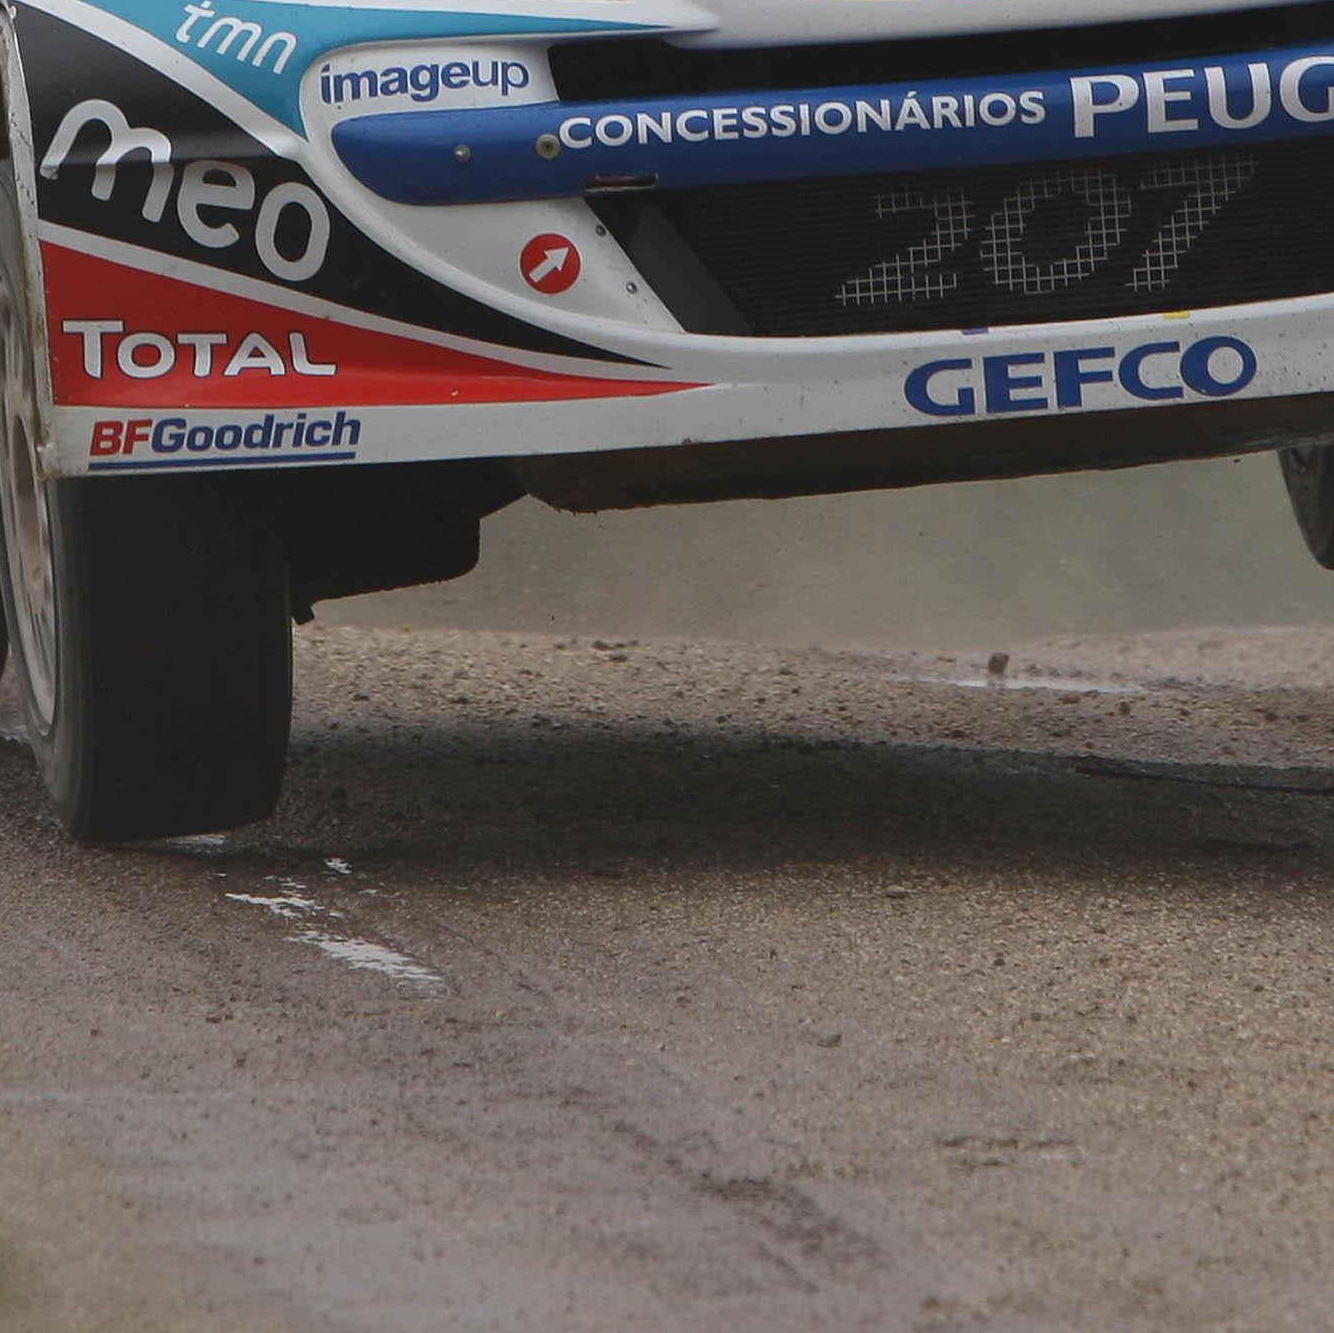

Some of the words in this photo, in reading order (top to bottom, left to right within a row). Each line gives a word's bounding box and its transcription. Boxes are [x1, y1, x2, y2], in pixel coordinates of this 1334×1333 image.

[175, 0, 298, 75] tmn
[319, 57, 530, 104] imageup
[559, 89, 1046, 151] CONCESSIONÁRIOS
[40, 99, 331, 282] meo
[835, 158, 1259, 307] 207
[63, 319, 338, 380] TOTAL
[904, 335, 1259, 418] GEFCO
[89, 411, 362, 457] BFGoodrich
